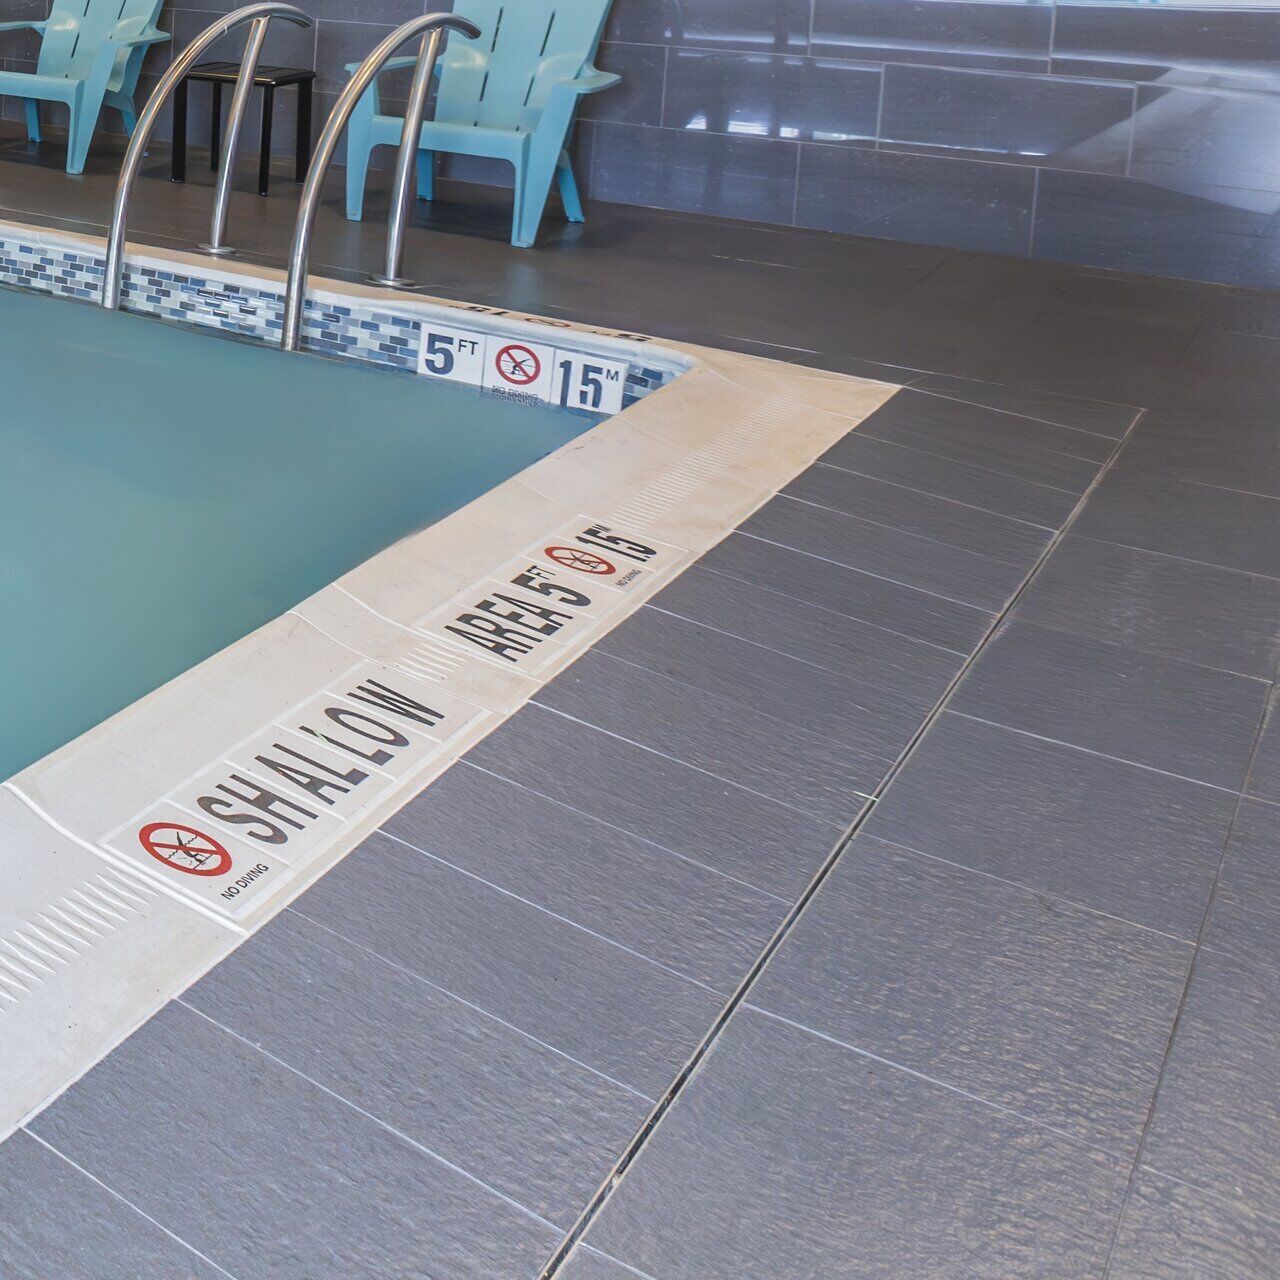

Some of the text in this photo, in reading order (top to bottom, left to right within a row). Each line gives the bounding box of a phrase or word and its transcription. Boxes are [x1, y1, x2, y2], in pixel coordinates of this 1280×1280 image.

[425, 332, 454, 375] 5
[458, 338, 479, 356] FT
[606, 369, 619, 382] M
[510, 565, 592, 607] 5 FT
[444, 592, 574, 663] AREA
[196, 678, 446, 845] SHALLOW
[220, 863, 269, 901] NO DIVING
